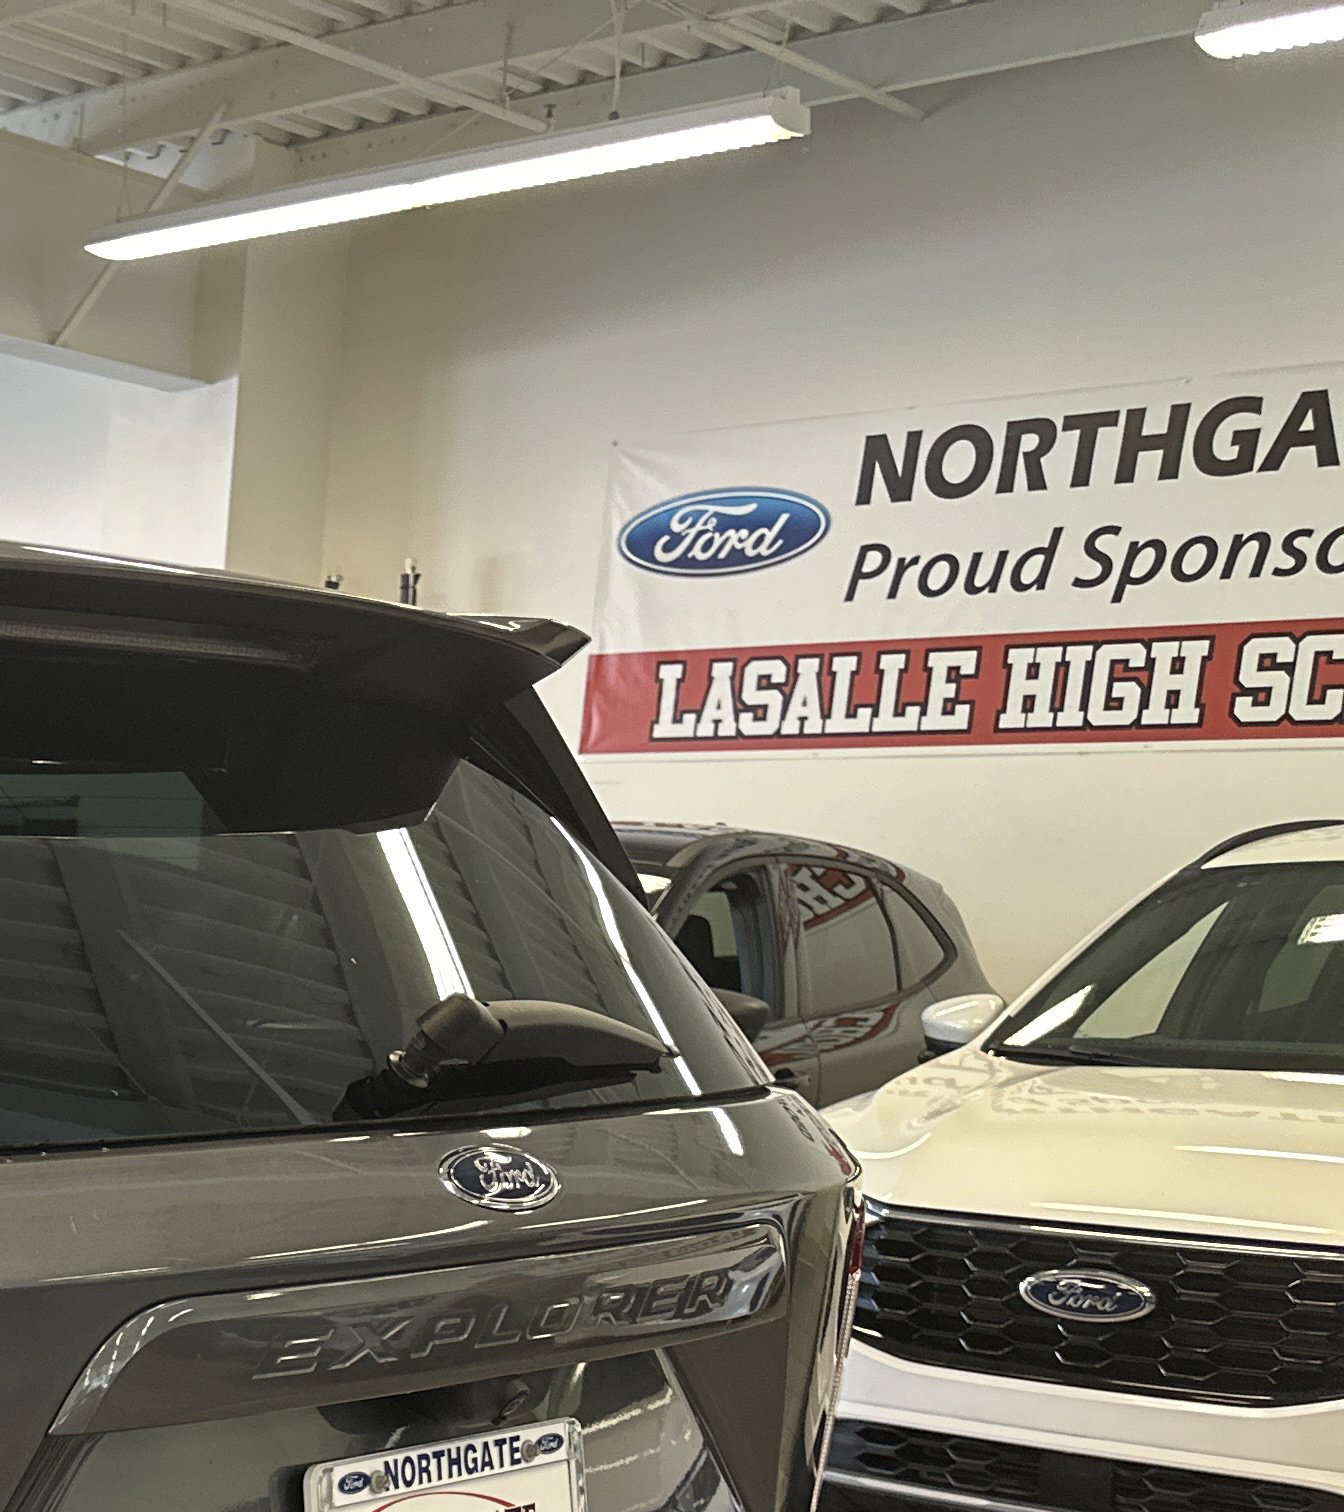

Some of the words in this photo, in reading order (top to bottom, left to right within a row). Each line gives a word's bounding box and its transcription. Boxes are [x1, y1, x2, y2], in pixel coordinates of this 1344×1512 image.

[855, 388, 1341, 506] NORTHGA
[653, 502, 791, 563] Ford
[844, 526, 1065, 601] Proud
[648, 646, 979, 743] LASALLE
[995, 634, 1215, 735] HIGH
[473, 1150, 540, 1196] Ford
[252, 1268, 734, 1380] EXPLORER
[1047, 1279, 1122, 1312] Ford
[383, 1435, 522, 1491] NORTHGATE
